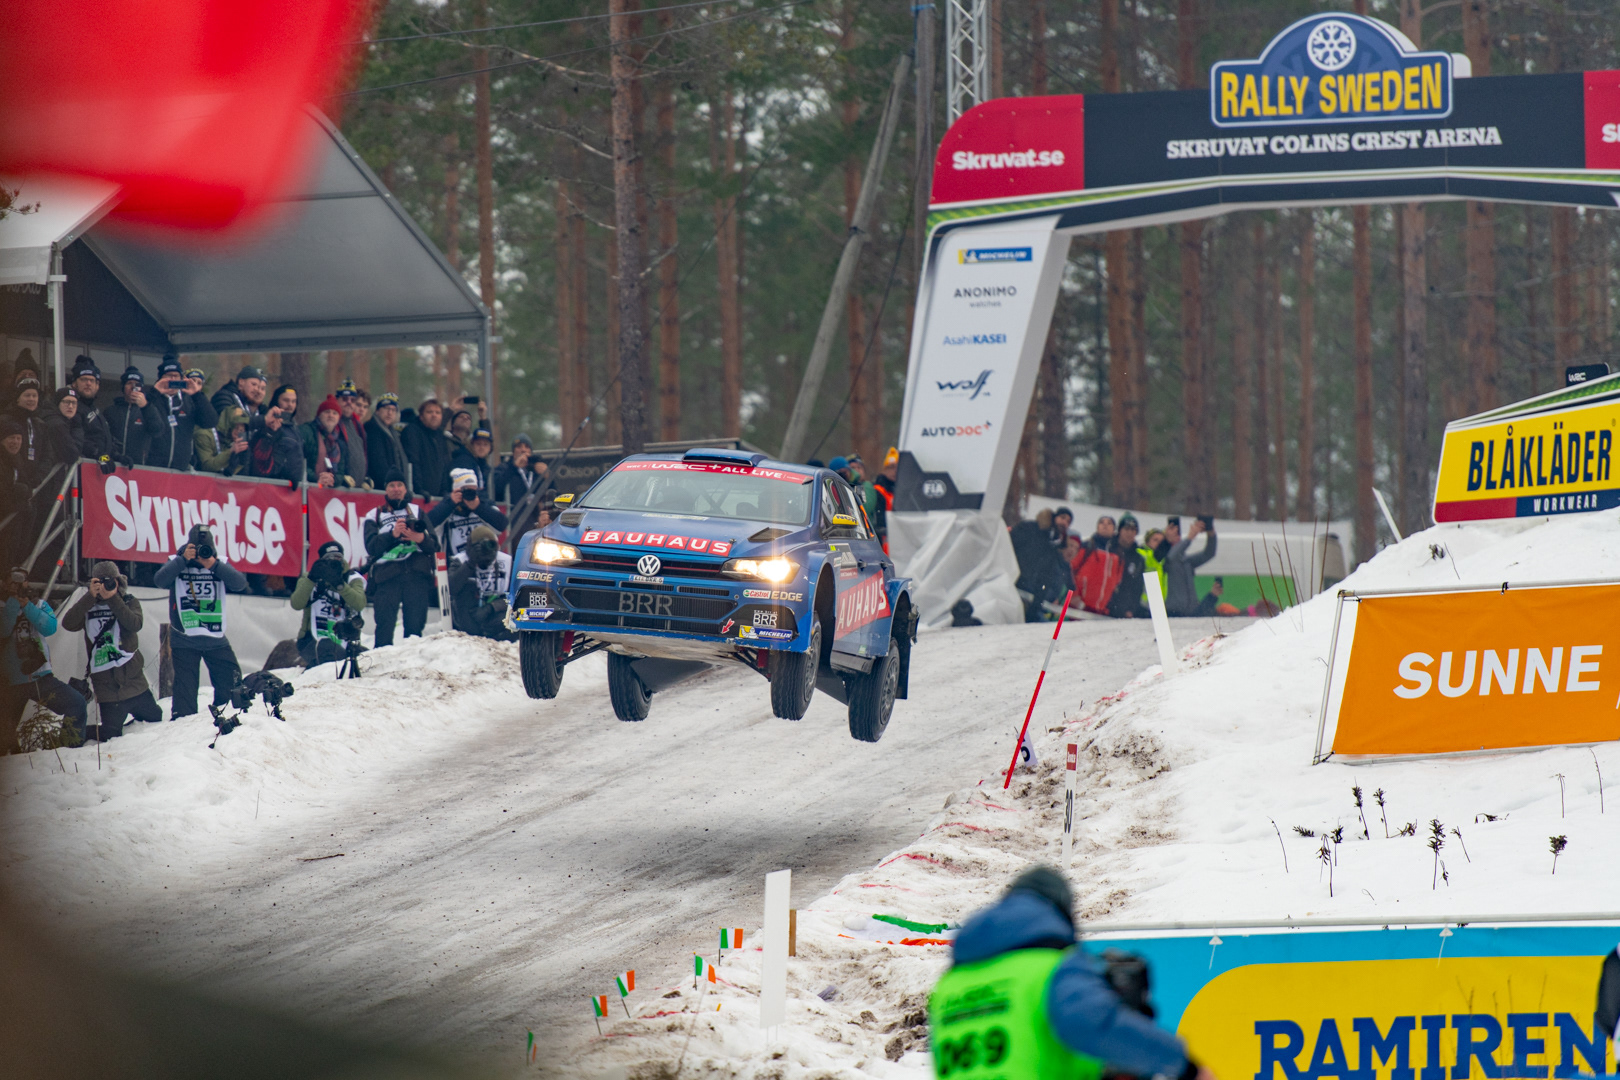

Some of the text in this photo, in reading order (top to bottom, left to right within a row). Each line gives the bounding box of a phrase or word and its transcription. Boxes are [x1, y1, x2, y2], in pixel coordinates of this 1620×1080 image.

[1220, 62, 1442, 118] RALLY SWEDEN
[1166, 126, 1502, 159] SKRUVAT COLINS CREST ARENA
[952, 149, 1065, 170] Skruvat.se
[954, 286, 1017, 298] ANONIMO
[921, 425, 982, 437] AUTODOC
[1467, 421, 1613, 491] BLÅKLÄDER
[722, 466, 748, 474] ALL
[751, 469, 783, 479] LIVE
[923, 482, 946, 496] FIA
[1534, 494, 1597, 512] WORKWEAR
[583, 531, 731, 553] BAUHAUS
[528, 572, 555, 582] EDGE
[186, 582, 212, 595] 235
[749, 590, 803, 602] Castrol EDGE
[529, 595, 548, 606] BRR
[618, 592, 673, 616] BRR
[753, 613, 778, 626] BRR
[758, 630, 792, 638] MICHELIN
[1392, 644, 1603, 700] SUNNE
[1064, 788, 1073, 834] 30
[1254, 1012, 1607, 1080] RAMIREN
